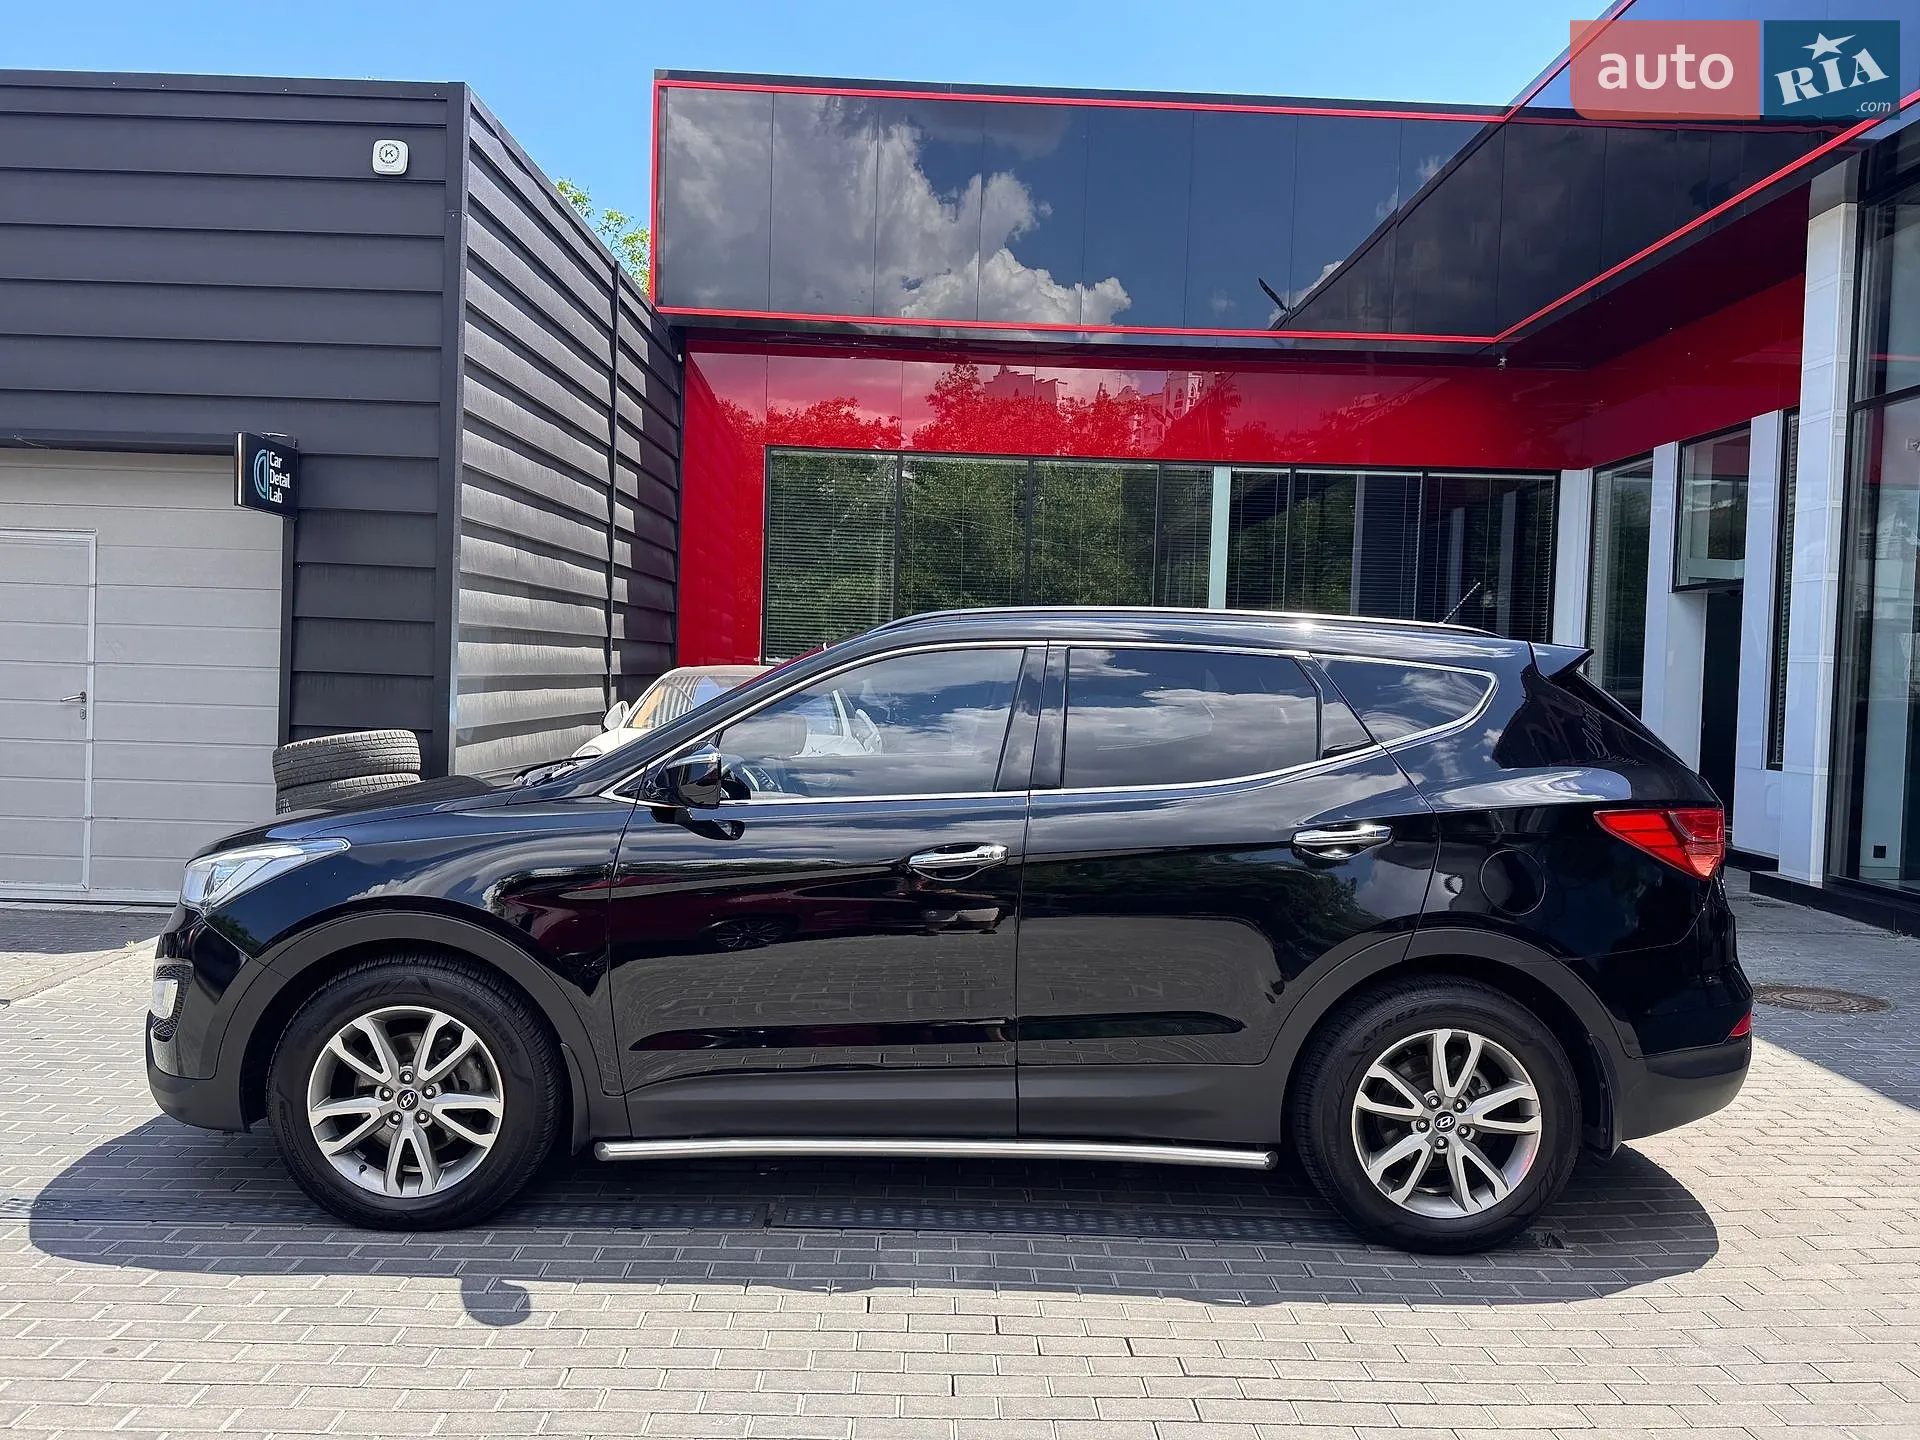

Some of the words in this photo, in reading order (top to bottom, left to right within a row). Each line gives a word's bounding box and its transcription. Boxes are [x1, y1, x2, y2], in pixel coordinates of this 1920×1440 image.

[269, 451, 283, 469] Car
[269, 468, 291, 489] Detail
[269, 485, 283, 504] Lab
